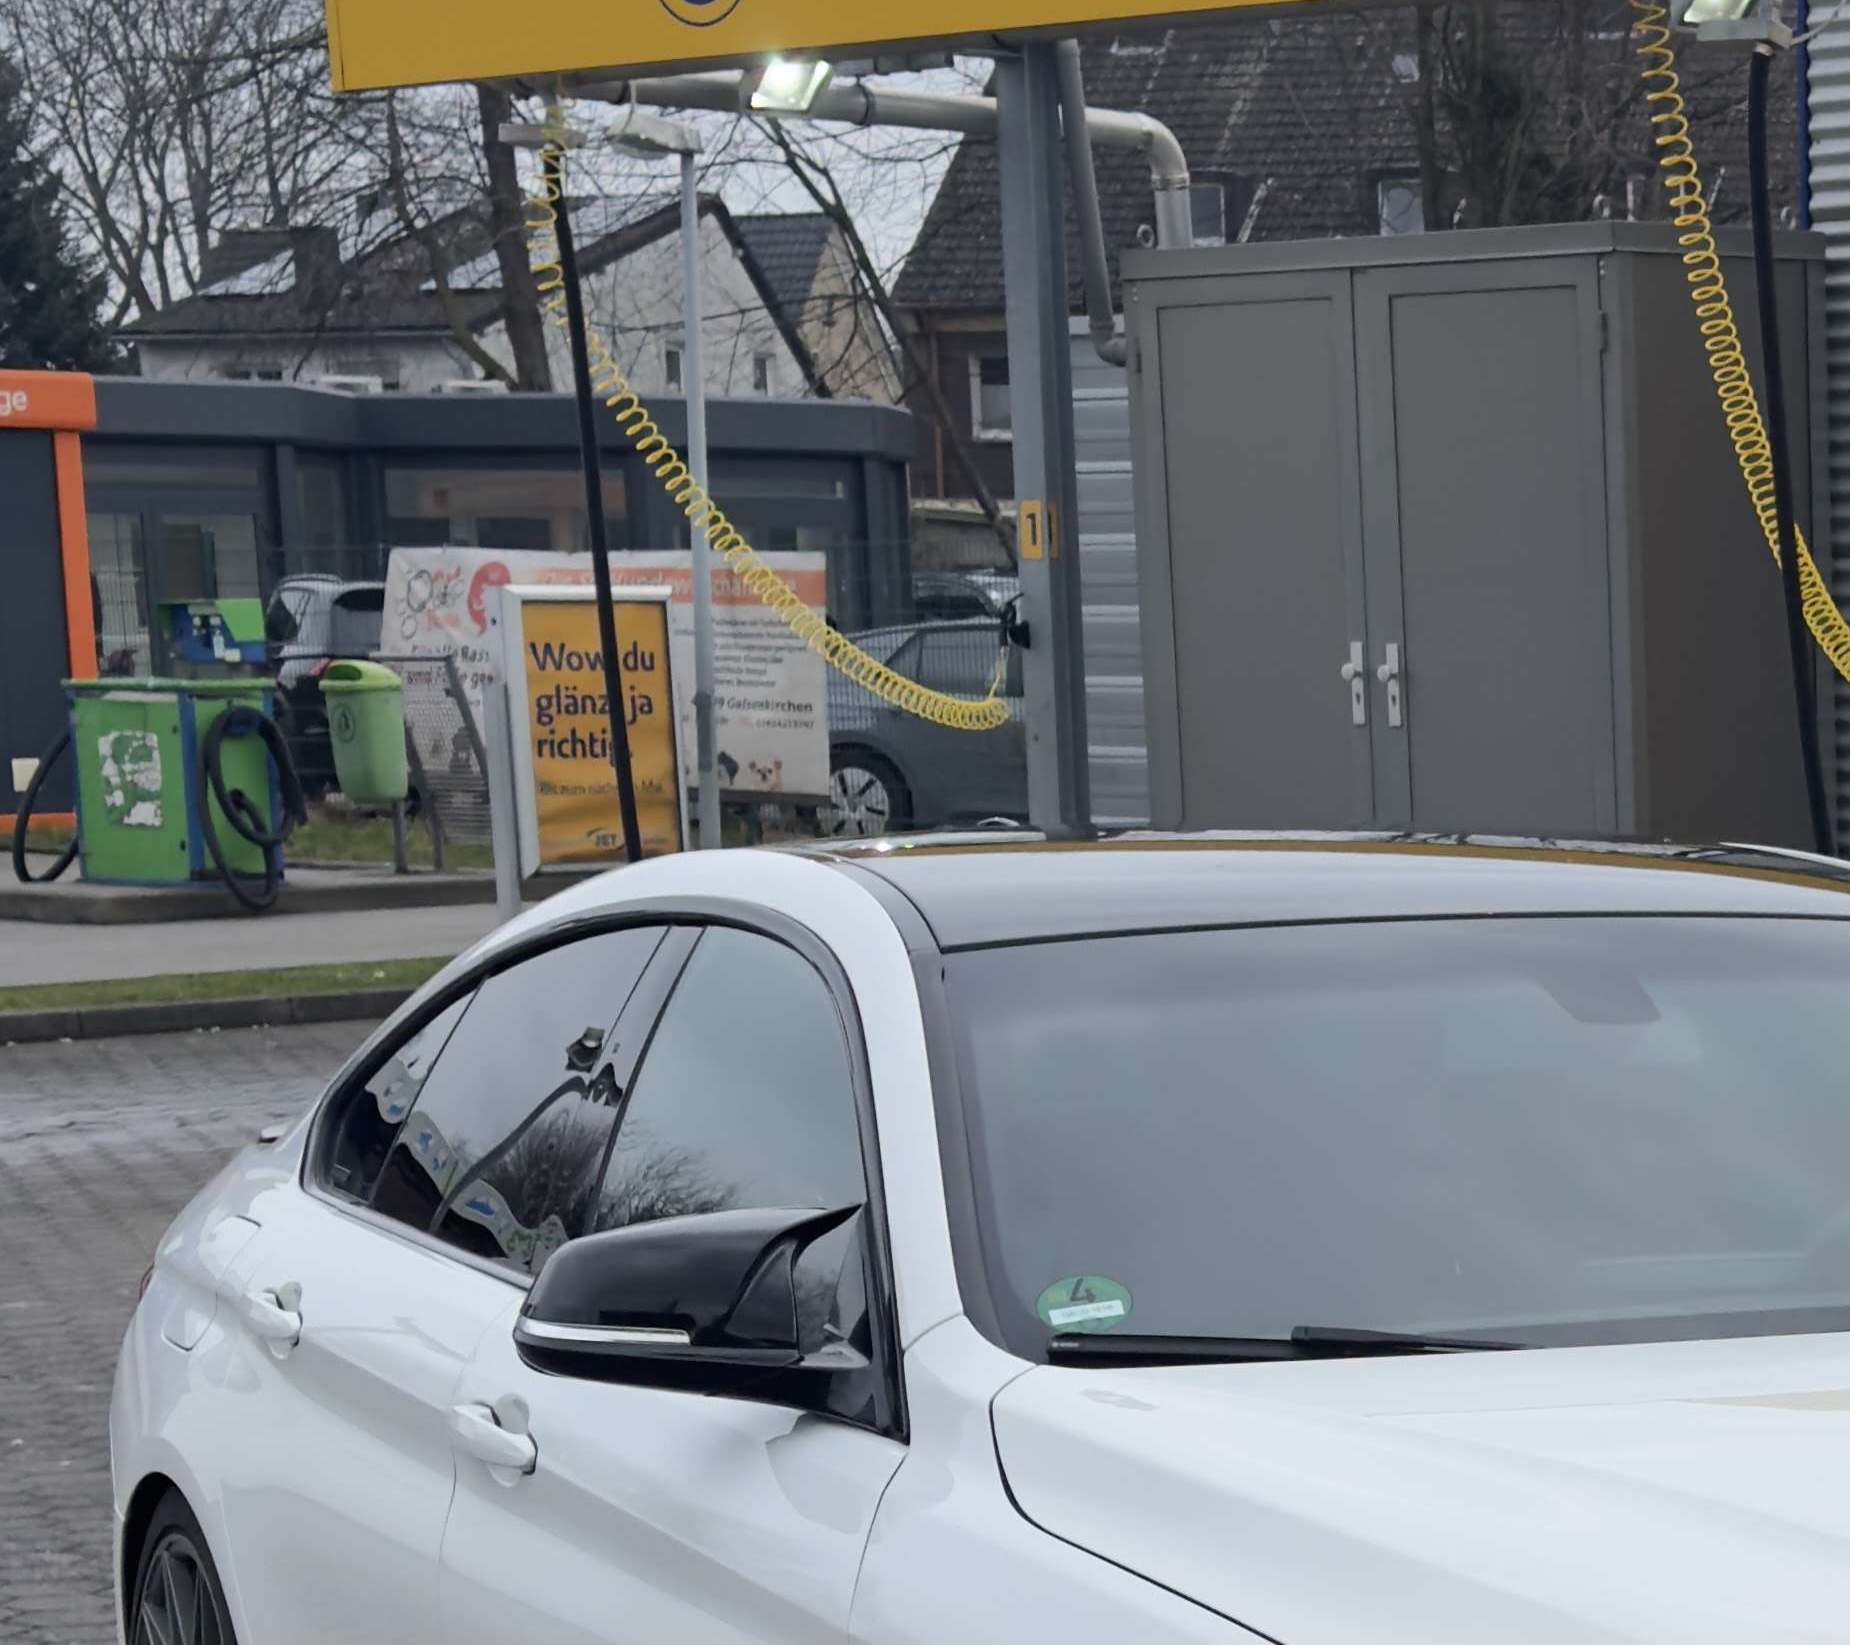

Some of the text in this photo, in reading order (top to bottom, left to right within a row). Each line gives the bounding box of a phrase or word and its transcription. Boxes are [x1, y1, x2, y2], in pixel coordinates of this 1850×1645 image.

[1025, 512, 1038, 546] 1
[622, 640, 656, 672] du
[535, 683, 654, 726] glänz ja
